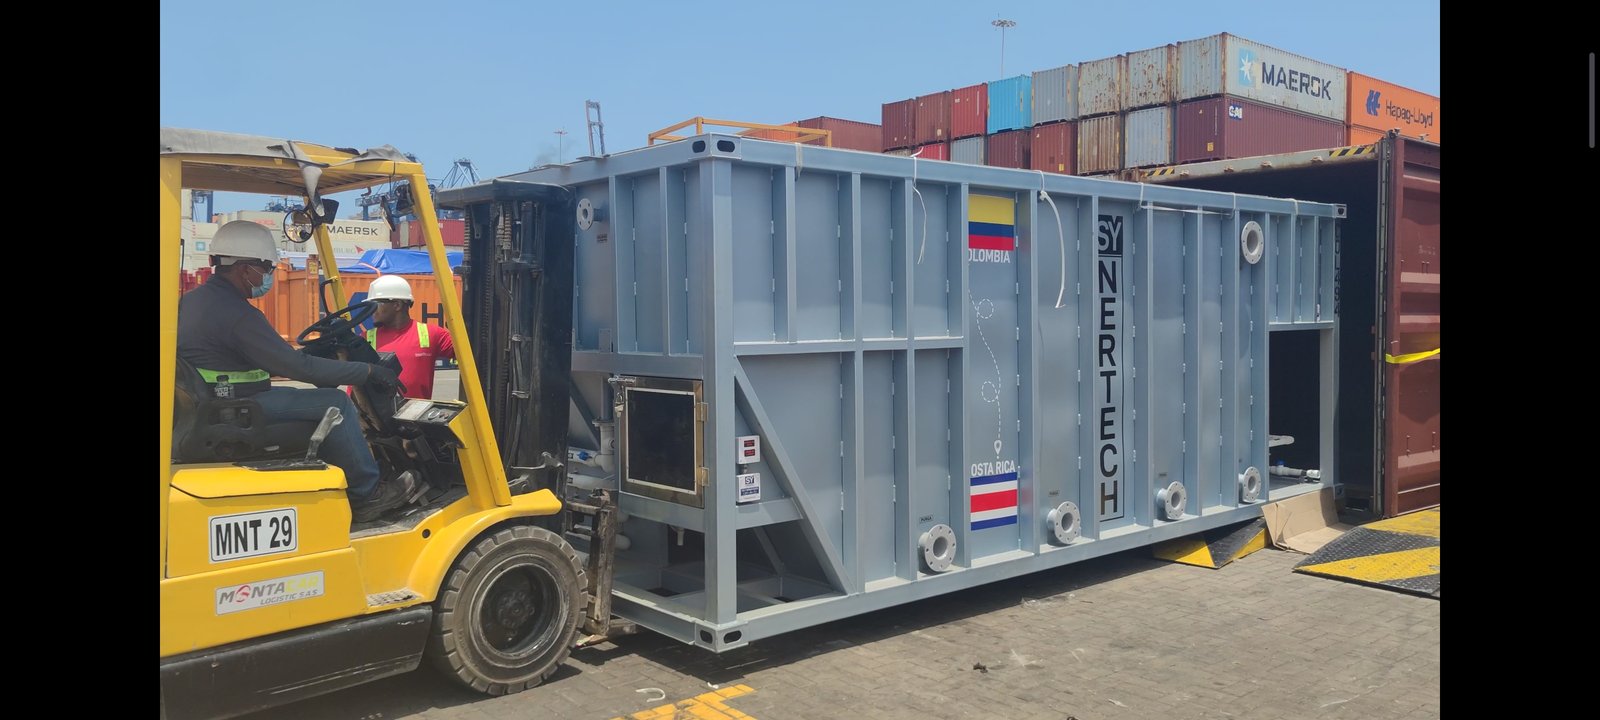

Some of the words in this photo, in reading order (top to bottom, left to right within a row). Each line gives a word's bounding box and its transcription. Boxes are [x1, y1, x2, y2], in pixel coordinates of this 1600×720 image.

[1262, 61, 1332, 101] MAERSK
[1385, 99, 1433, 128] Hapag-Lloyd
[326, 225, 378, 236] MAERSK
[968, 248, 1011, 264] OLOMBIA
[970, 462, 994, 477] OSTA
[995, 459, 1016, 475] RICA
[215, 519, 262, 556] MNT
[269, 515, 293, 548] 29
[219, 575, 319, 605] MONTACAR
[260, 592, 297, 605] LOGISTIC
